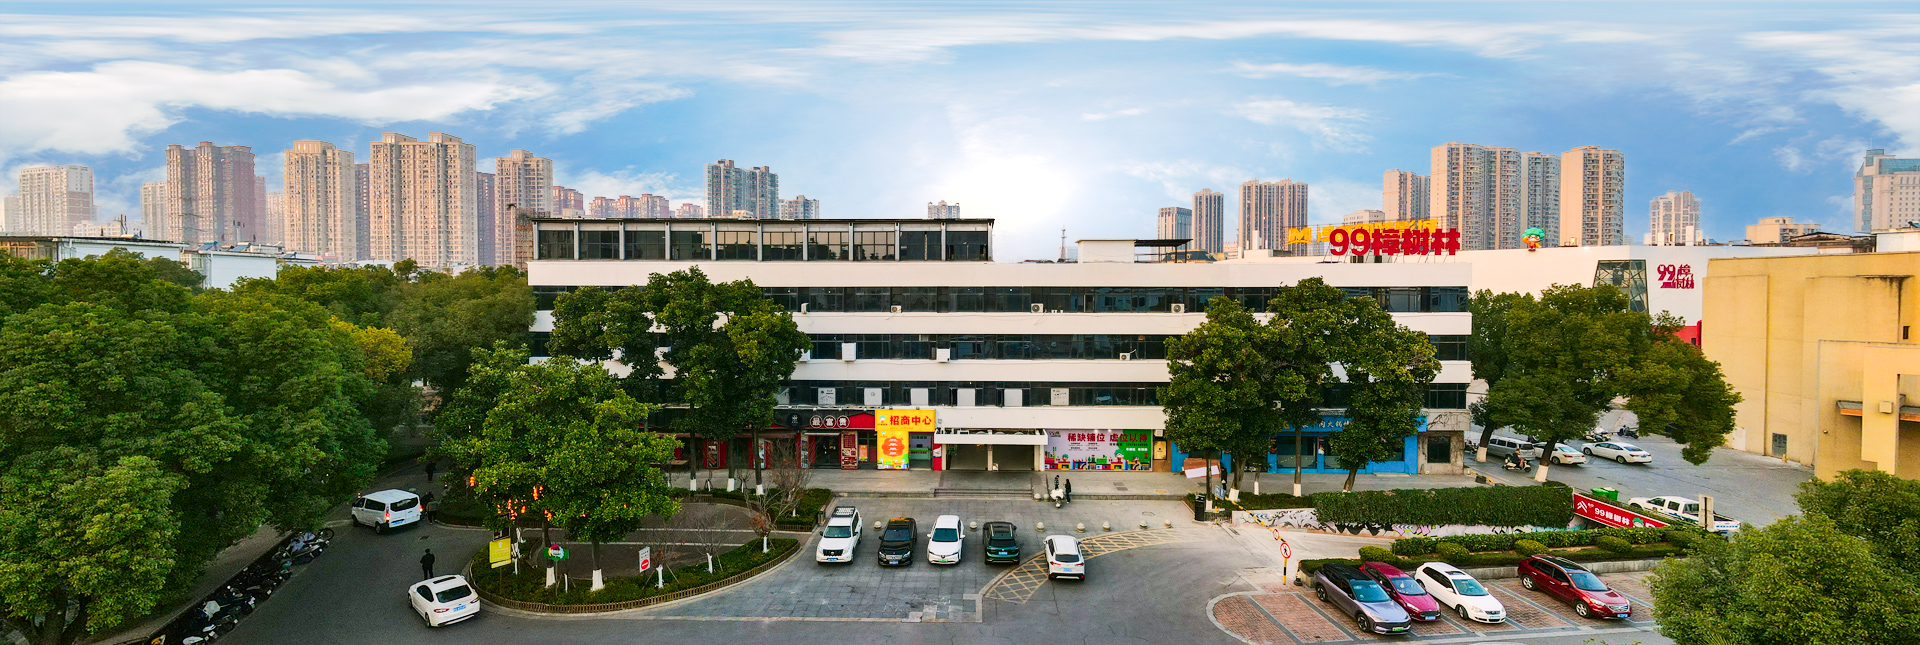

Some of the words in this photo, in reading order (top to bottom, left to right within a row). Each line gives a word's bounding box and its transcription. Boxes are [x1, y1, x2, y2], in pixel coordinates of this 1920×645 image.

[1329, 228, 1461, 256] 99樟树林
[889, 415, 932, 426] 招商中心
[1067, 433, 1106, 442] 稀缺铺位
[1109, 433, 1148, 442] 虚位以待
[1594, 507, 1630, 526] 99樟树林
